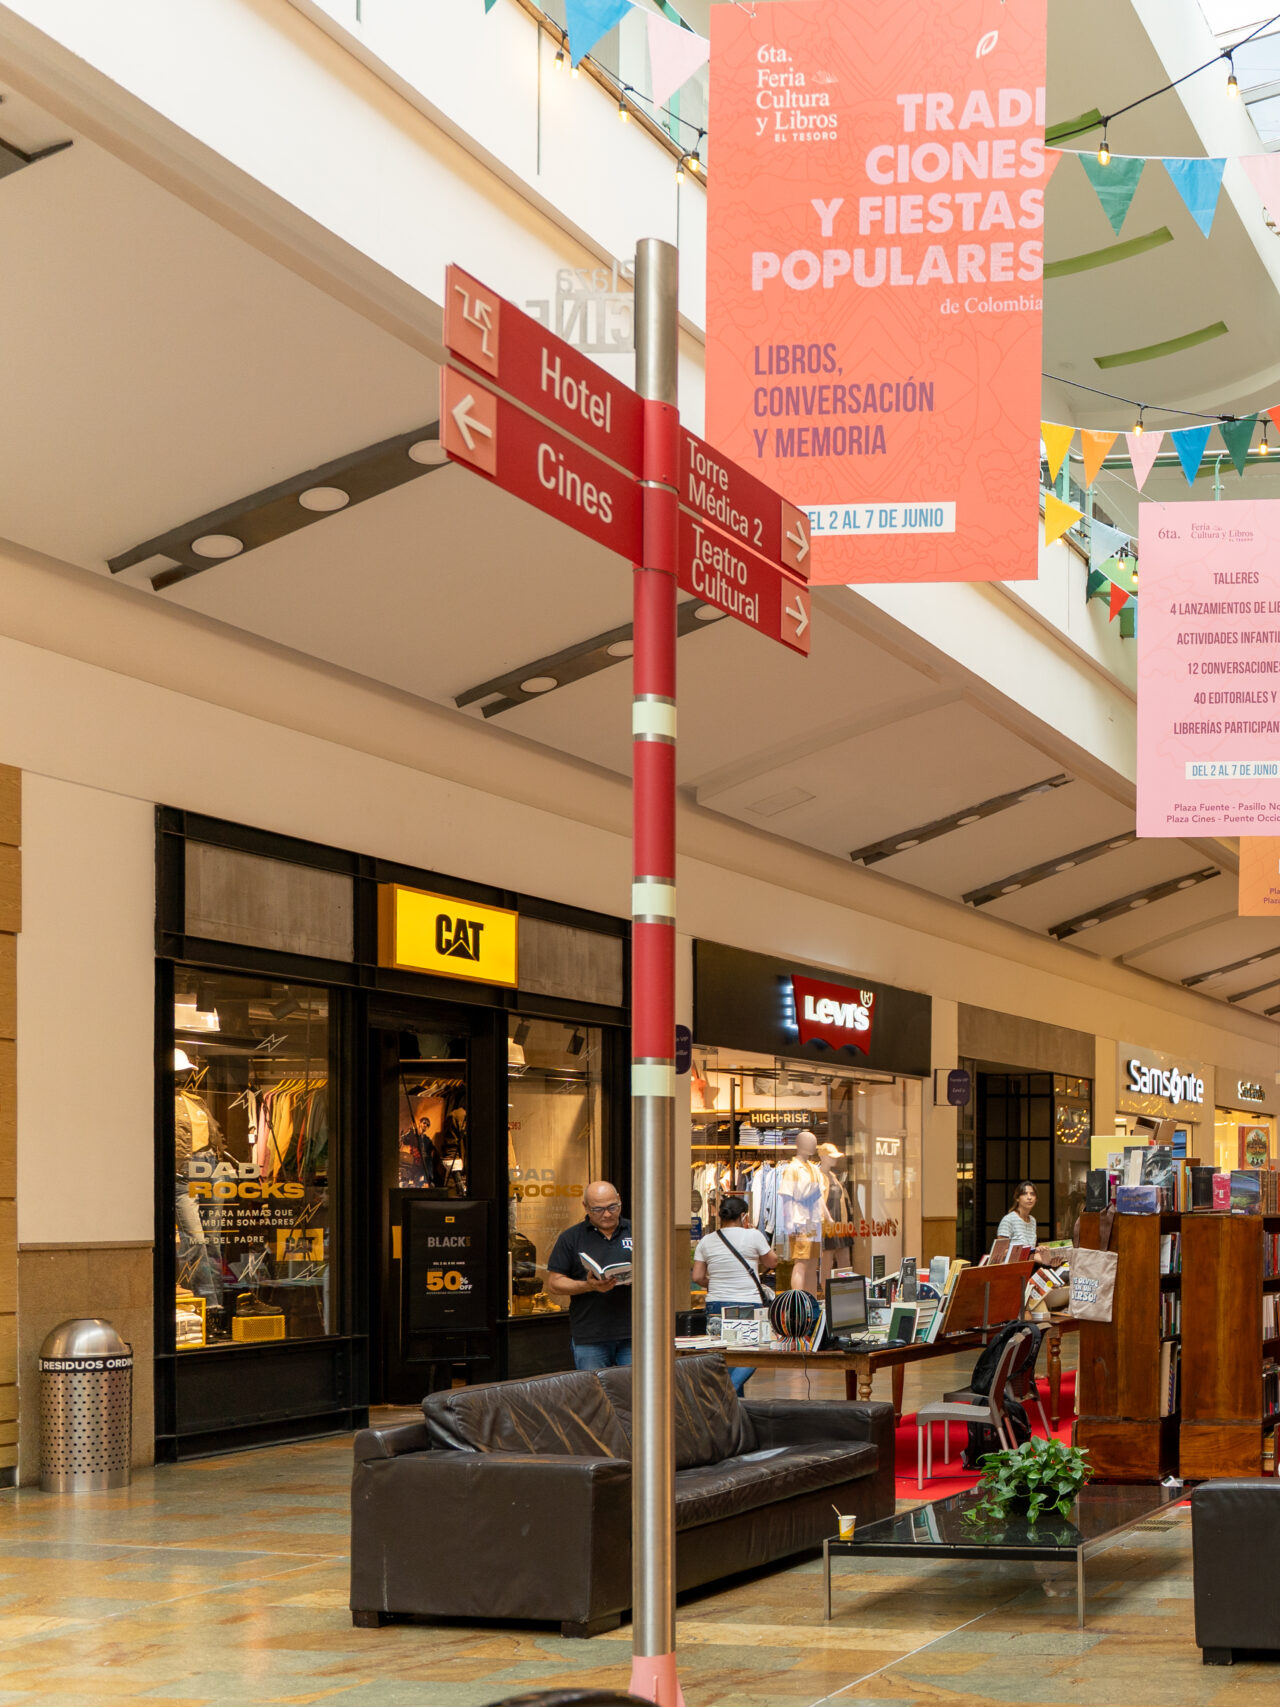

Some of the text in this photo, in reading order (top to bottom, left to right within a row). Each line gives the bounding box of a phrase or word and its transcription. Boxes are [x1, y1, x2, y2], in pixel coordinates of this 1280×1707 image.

[757, 44, 793, 64] 6ta.
[756, 68, 805, 88] Feria
[756, 91, 830, 109] Cultura
[897, 87, 1045, 132] TRADI
[756, 110, 838, 135] y Libros
[775, 131, 838, 142] EL TESORO
[865, 138, 1045, 185] CIONES
[811, 188, 1044, 237] Y FIESTAS
[751, 240, 1043, 291] POPULARES
[940, 295, 1043, 315] de Colombia
[754, 343, 843, 376] LIBROS,
[541, 347, 612, 433] Hotel
[754, 376, 934, 418] CONVERSACIÓN
[754, 425, 887, 459] Y MEMORIA
[686, 437, 729, 492] Torre
[537, 442, 614, 524] Cines
[688, 475, 763, 547] Médica 2
[807, 507, 944, 531] EL 2 AL 7 DE JUNIO
[1158, 528, 1181, 540] 6ta.
[1190, 529, 1254, 540] Cultura y Libros
[1191, 523, 1210, 531] Feria
[692, 523, 748, 586] Teatro
[1214, 571, 1260, 585] TALLERES
[690, 561, 760, 624] Cultural
[1170, 603, 1176, 615] 4
[1179, 601, 1251, 615] LANZAMIENTOS
[1254, 601, 1266, 614] DE
[1177, 631, 1238, 645] ACTIVIDADES
[1188, 662, 1199, 675] 12
[1194, 691, 1277, 704] 40 EDITORIALES Y
[1174, 719, 1222, 735] LIBRERÍAS
[1192, 763, 1278, 777] DEL 2 AL 7 DE JUNIO
[1174, 804, 1197, 812] Plaza
[1199, 803, 1230, 811] Fuente
[1238, 802, 1266, 811] Pasillo
[1166, 815, 1189, 823] Plaza
[1192, 814, 1216, 823] Cines
[1223, 814, 1254, 822] Puente
[435, 913, 484, 962] CAT
[804, 994, 870, 1031] Levi's
[1127, 1059, 1204, 1105] Samsonite
[751, 1113, 809, 1124] HIGH-RISE
[188, 1161, 261, 1179] DAD
[188, 1181, 305, 1199] ROCKS
[509, 1184, 584, 1198] ROCKS
[259, 1218, 295, 1226] PADRES
[234, 1235, 264, 1244] PADRE
[427, 1236, 466, 1248] BLACK
[426, 1271, 462, 1291] 50
[43, 1360, 104, 1370] RESIDUOS
